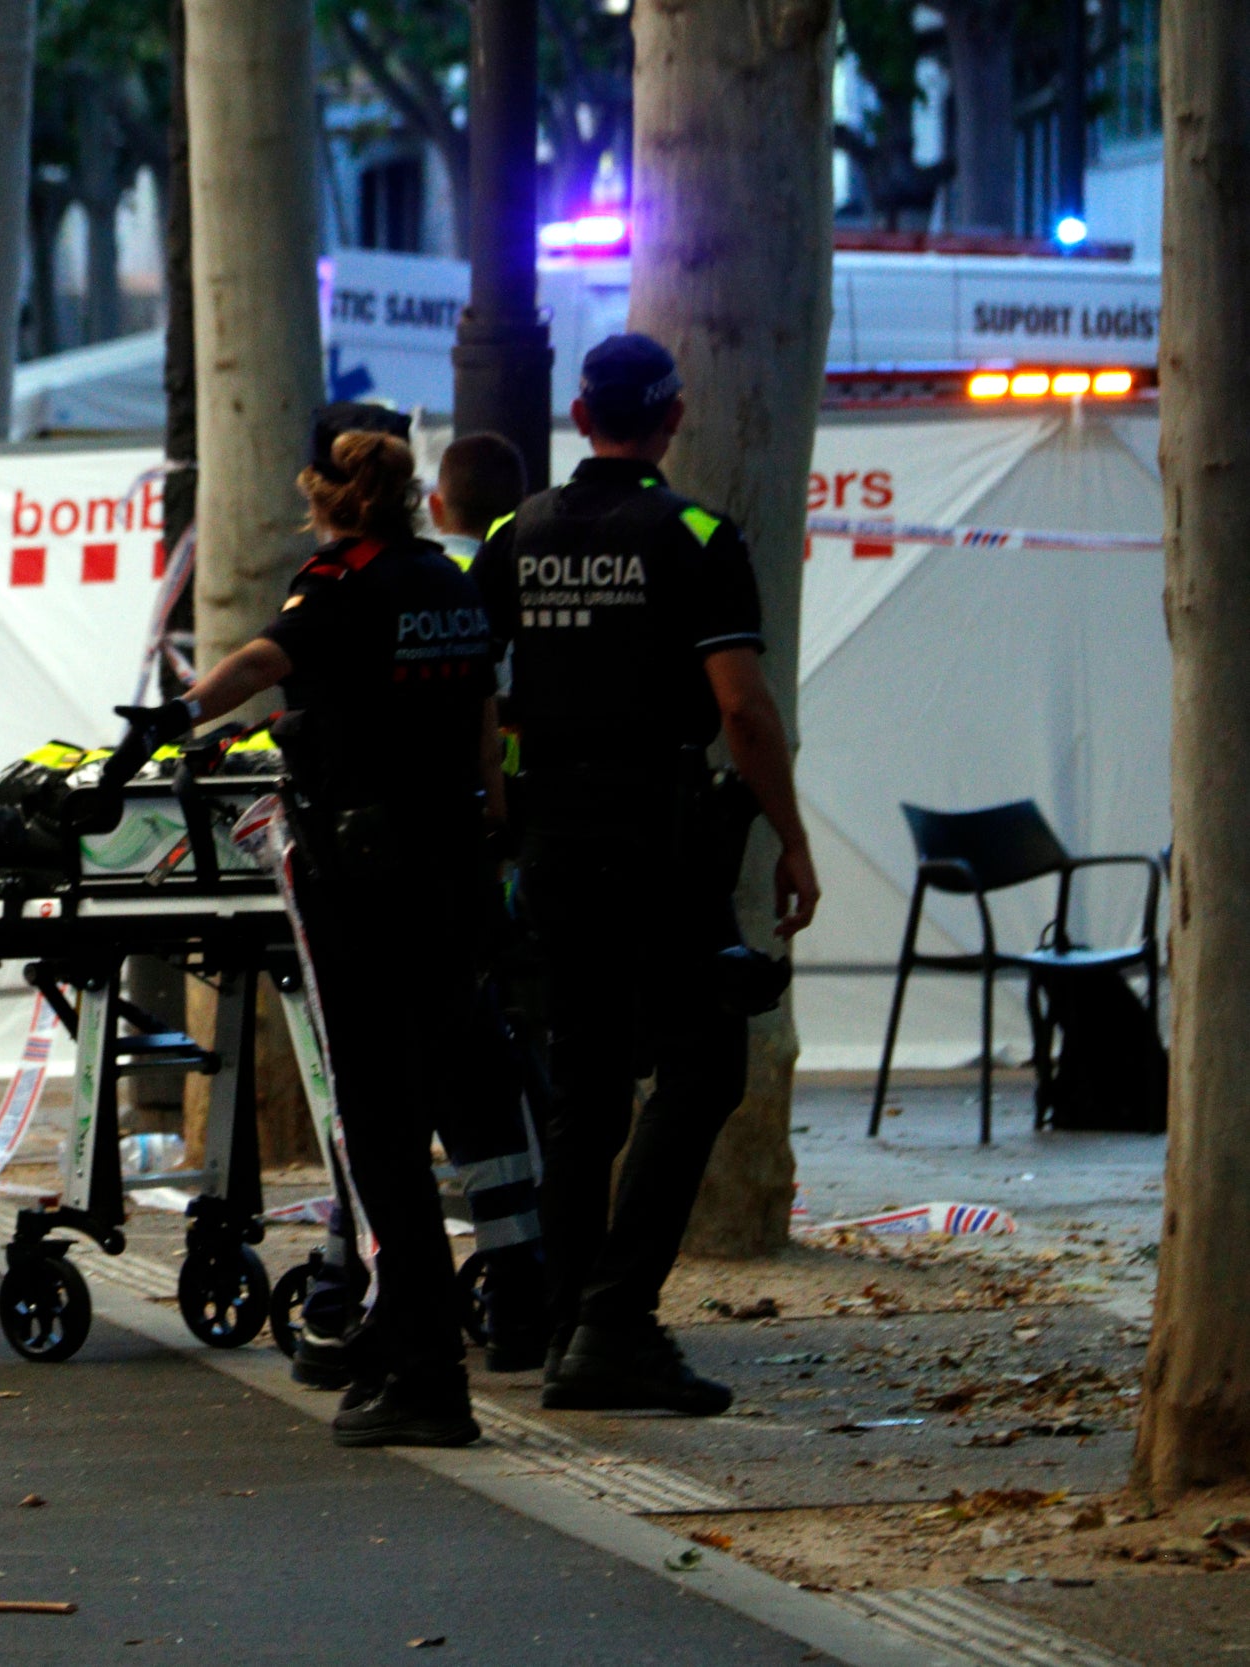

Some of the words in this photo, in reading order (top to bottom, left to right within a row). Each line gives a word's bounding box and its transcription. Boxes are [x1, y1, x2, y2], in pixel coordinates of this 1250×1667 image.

[974, 302, 1071, 337] SUPORT
[517, 555, 646, 587] POLICIA
[396, 608, 490, 642] POLICIA
